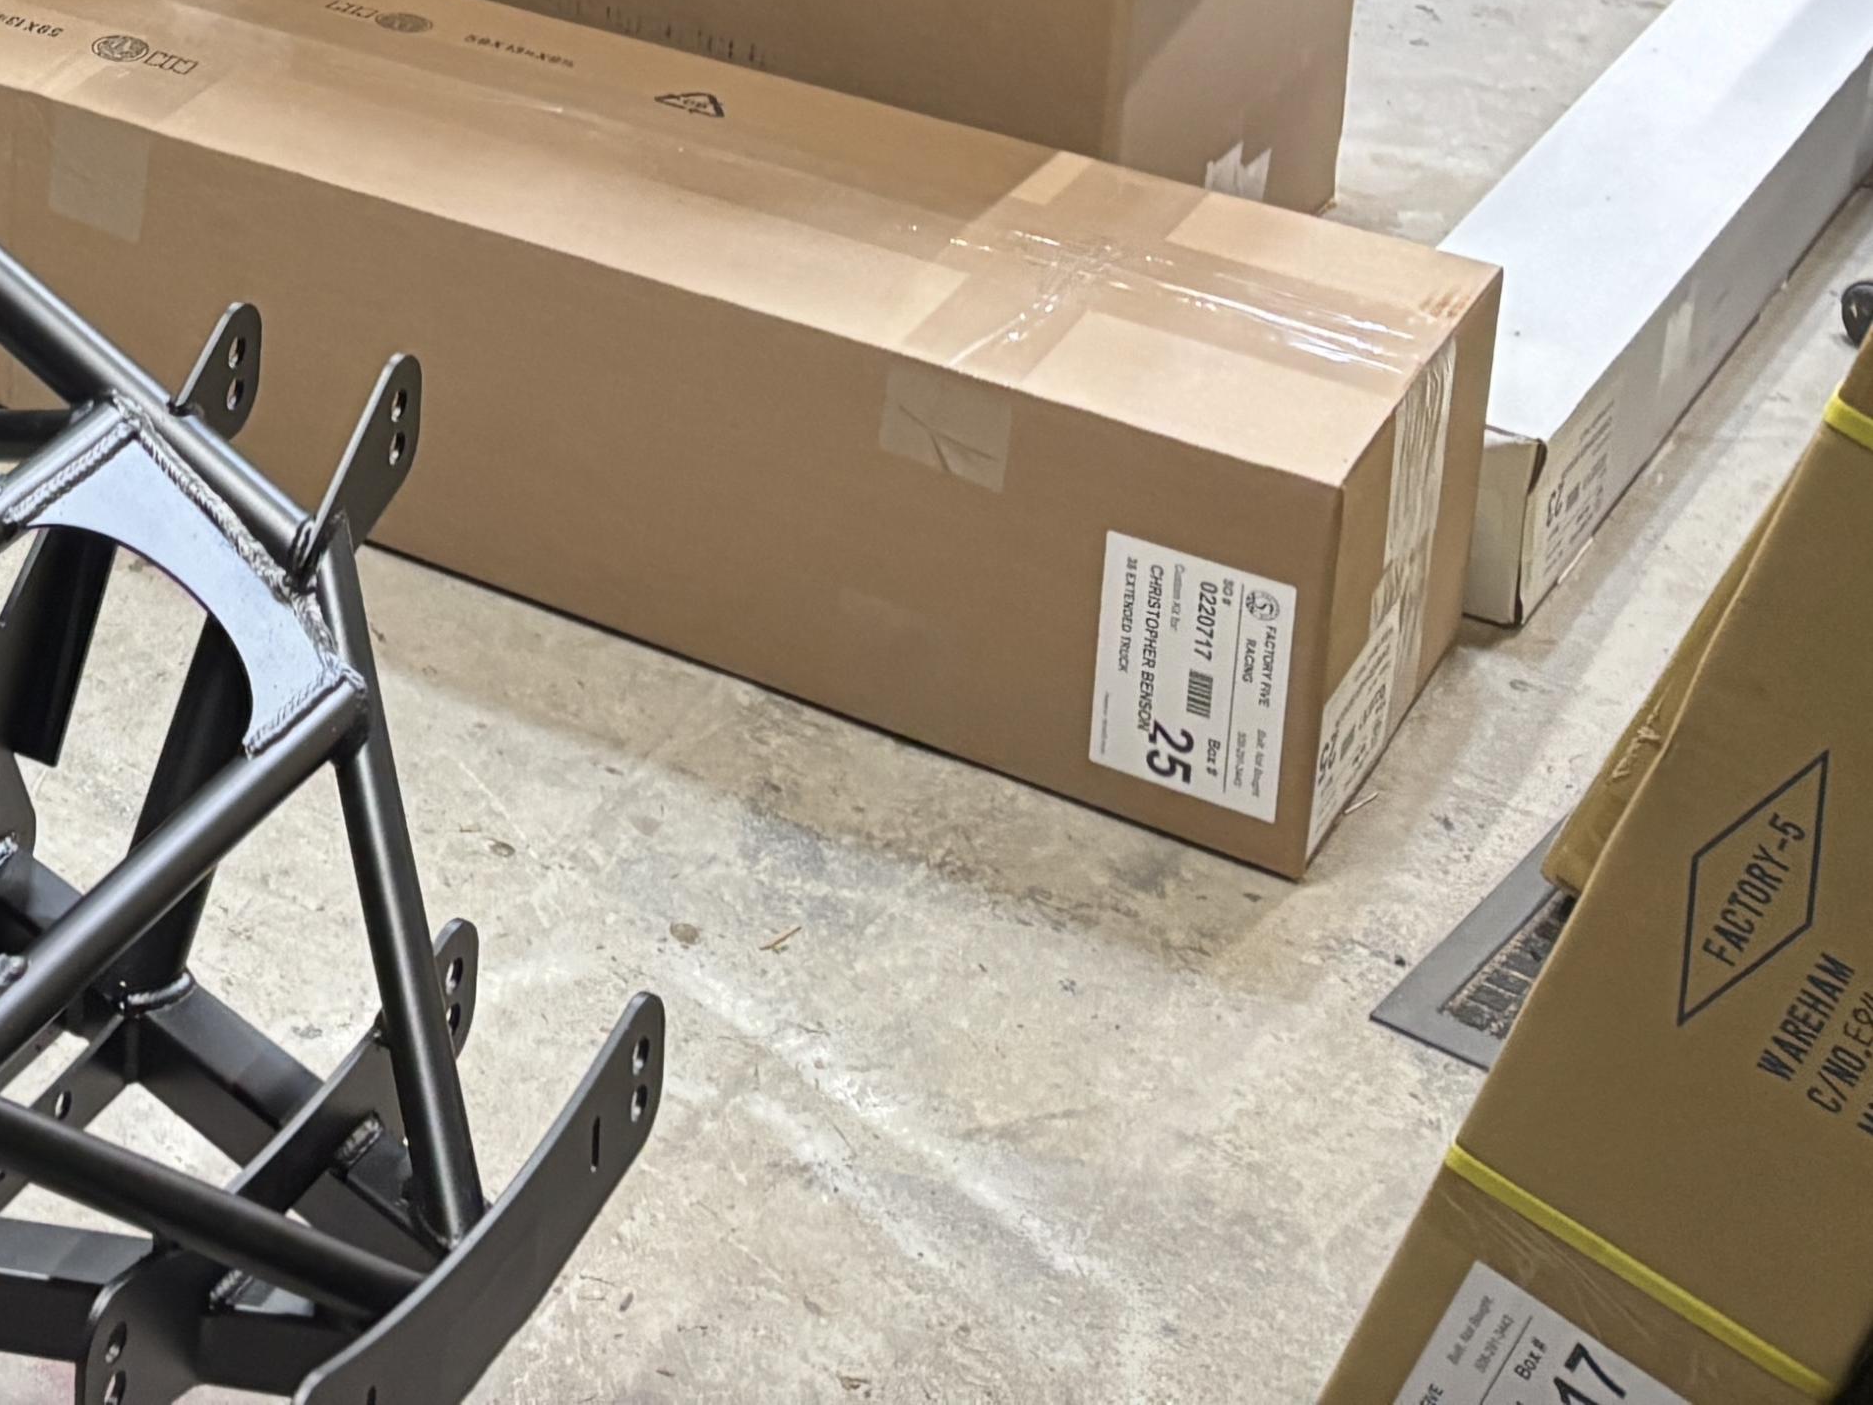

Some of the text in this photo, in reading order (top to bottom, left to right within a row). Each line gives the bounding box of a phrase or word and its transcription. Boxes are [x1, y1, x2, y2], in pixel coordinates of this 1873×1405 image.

[1135, 563, 1163, 733] CHRISTOPHER BENSON
[1192, 579, 1217, 661] 0220717
[1144, 717, 1195, 786] 25
[1702, 812, 1806, 967] FACTORY-5
[1756, 951, 1855, 1082] WAREHAM
[1513, 1354, 1540, 1381] Box
[1554, 1342, 1626, 1405] 17
